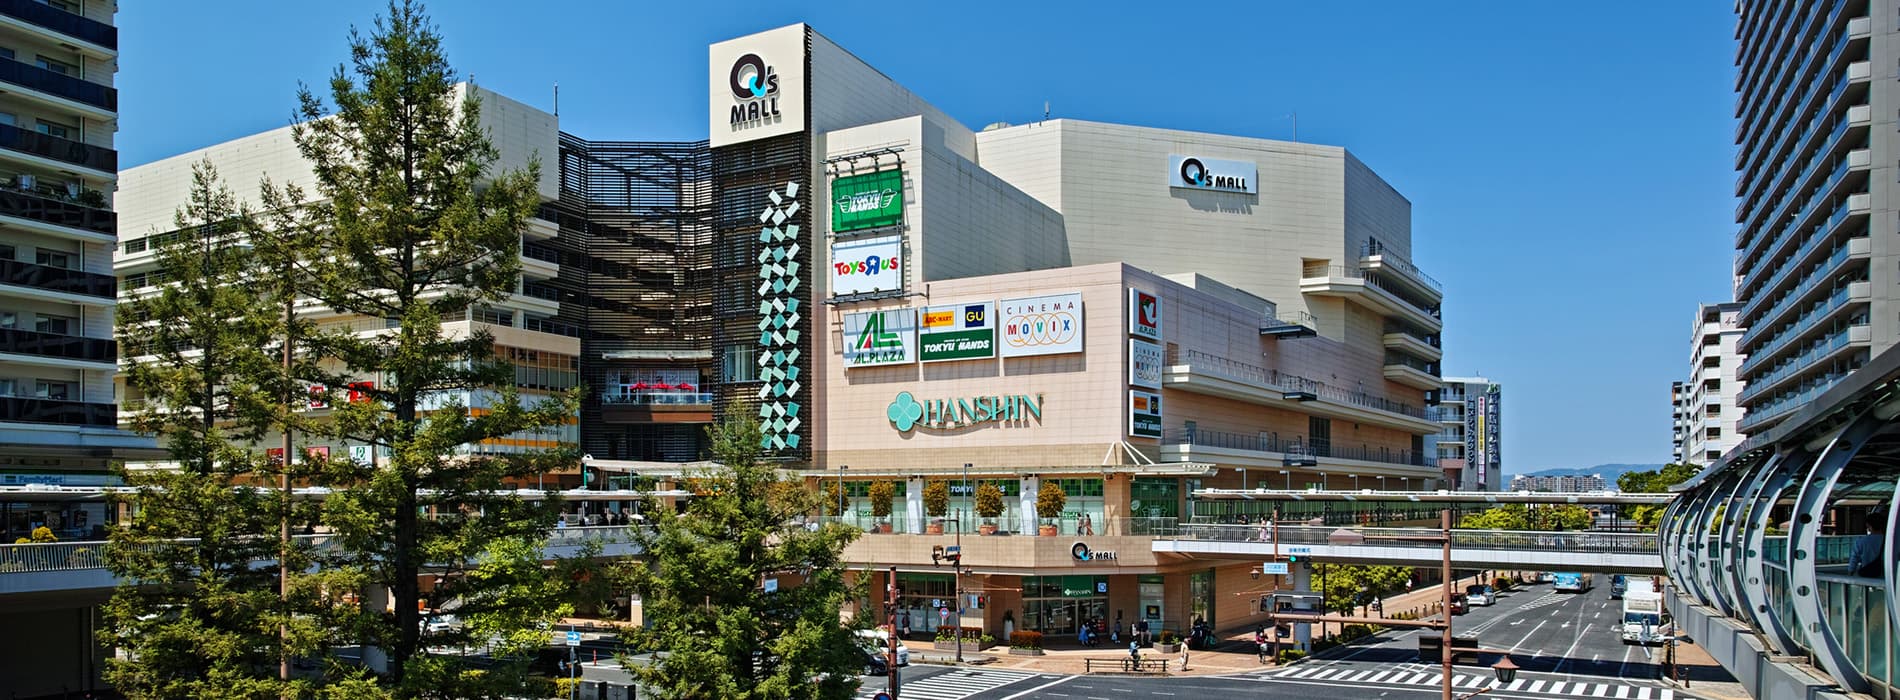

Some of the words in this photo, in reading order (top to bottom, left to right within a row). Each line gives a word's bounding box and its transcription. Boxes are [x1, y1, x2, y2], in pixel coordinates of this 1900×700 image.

[730, 53, 778, 98] Q's
[730, 97, 779, 124] MALL
[1181, 158, 1213, 187] Q's
[1215, 176, 1247, 190] MALL
[1006, 301, 1074, 315] CINEMA
[967, 311, 984, 322] GU
[1007, 320, 1070, 335] MOVIX
[924, 343, 955, 353] TOKYU
[958, 340, 990, 351] HANDS
[854, 350, 905, 364] AL.PLAZA
[923, 393, 1043, 425] HANSHIN
[1072, 542, 1093, 560] Q's
[1096, 552, 1117, 560] MALL
